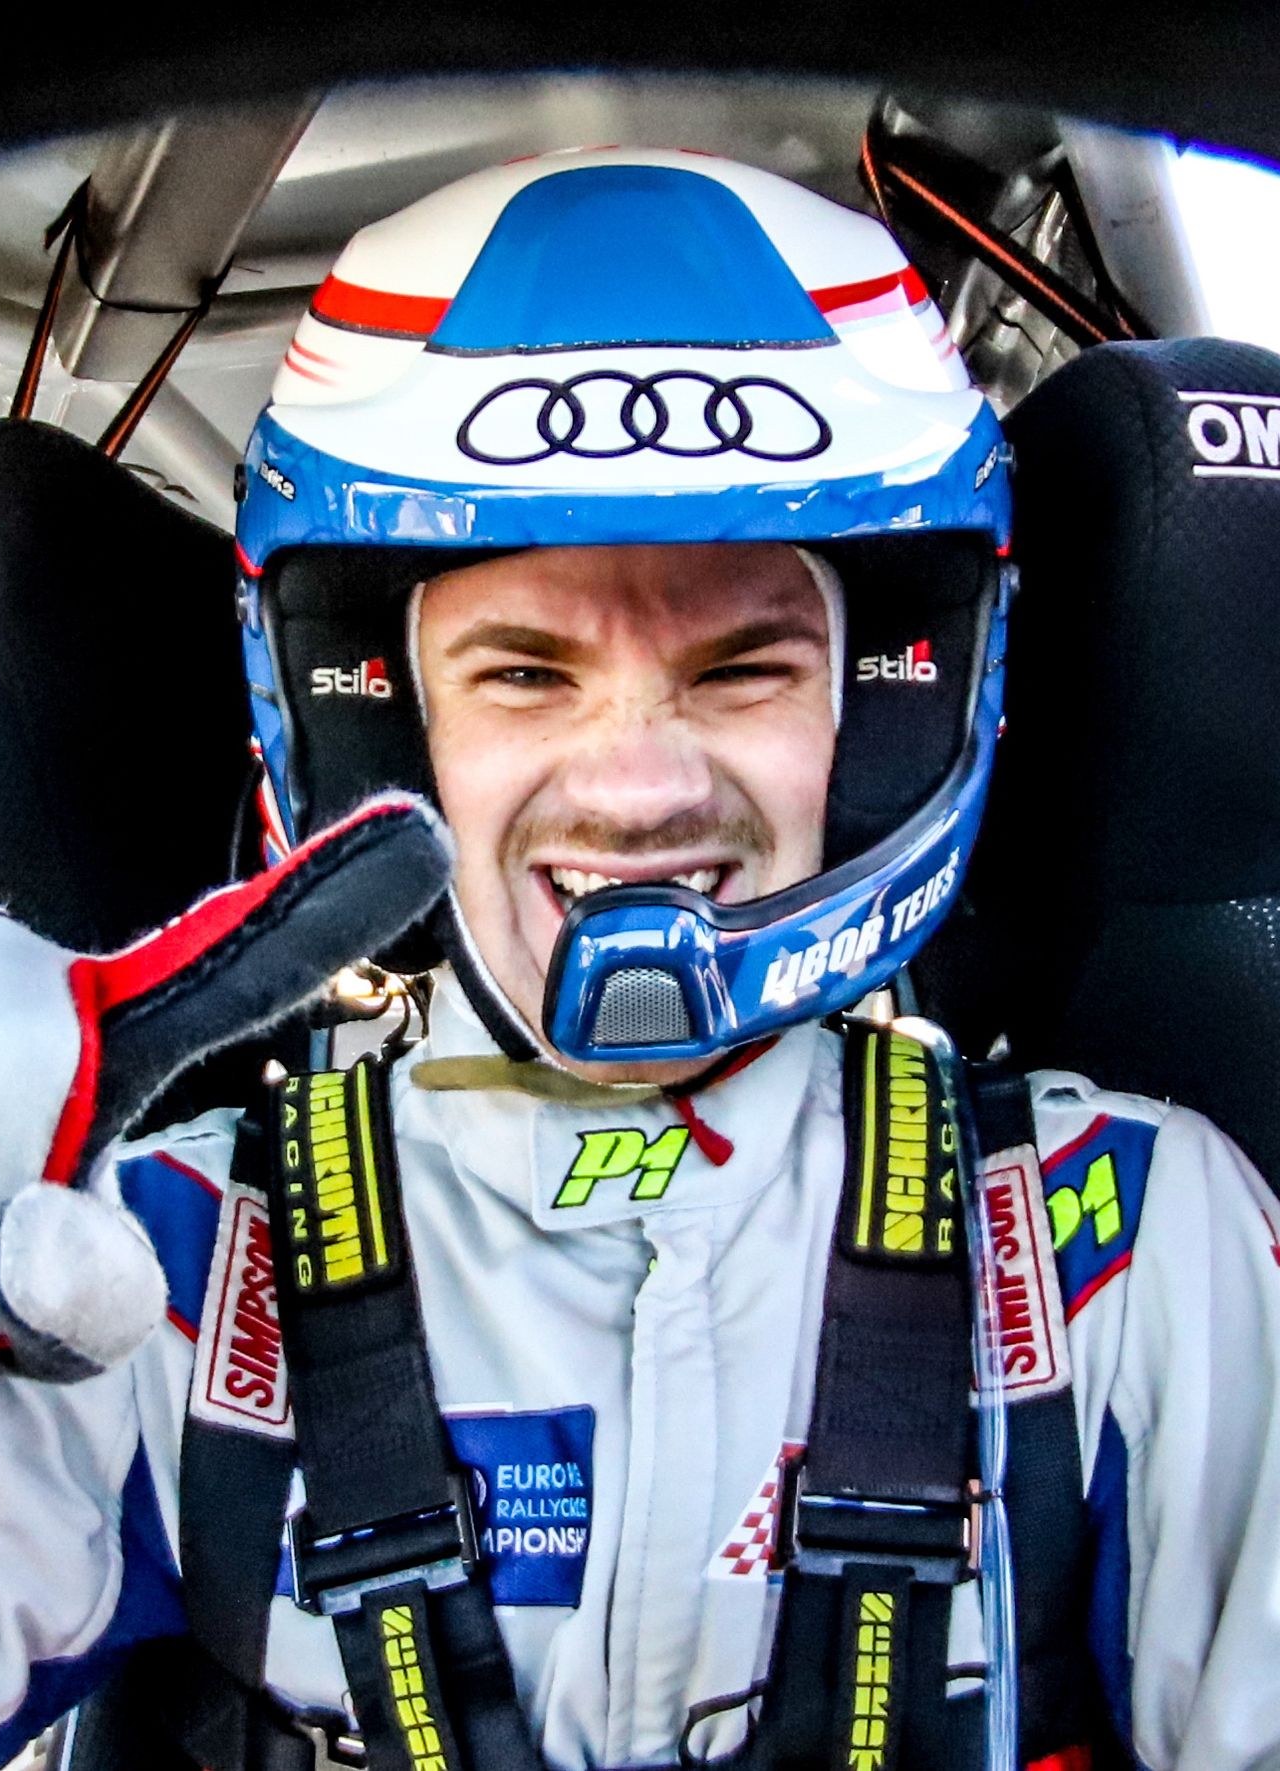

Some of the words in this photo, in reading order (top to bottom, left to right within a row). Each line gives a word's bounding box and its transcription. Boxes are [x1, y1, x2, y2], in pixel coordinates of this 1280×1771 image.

[310, 659, 393, 698] Stilo
[856, 644, 938, 682] Stilo
[284, 1076, 313, 1289] RACING
[550, 1124, 692, 1209] P1
